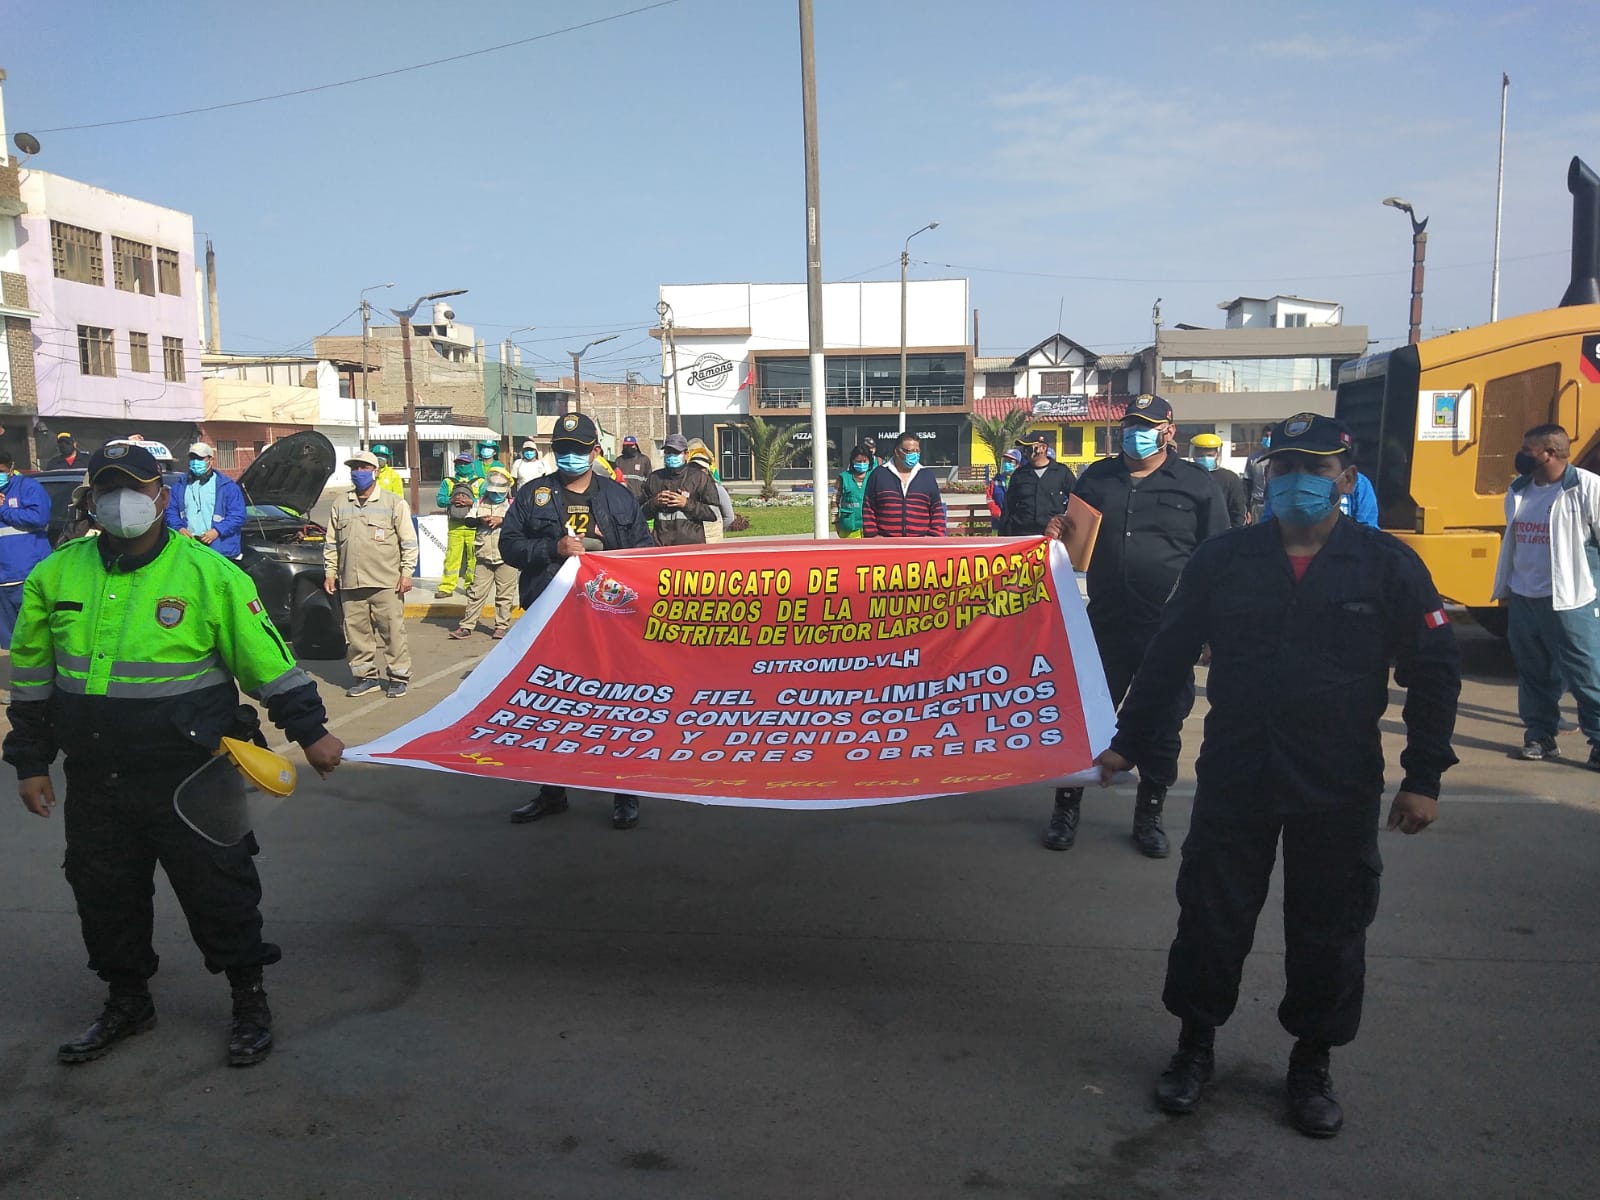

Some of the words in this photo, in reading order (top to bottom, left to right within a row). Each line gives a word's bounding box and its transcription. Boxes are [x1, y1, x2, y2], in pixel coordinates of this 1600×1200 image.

[878, 431, 936, 439] HAMBESAS
[566, 513, 590, 533] 42
[658, 568, 791, 597] SINDICATO
[808, 567, 839, 594] DE
[856, 540, 1048, 592] TRABAJADOR
[644, 615, 752, 647] DISTRITAL
[757, 625, 787, 646] DE
[792, 622, 872, 645] VICTOR
[876, 609, 949, 640] LARCO
[652, 599, 761, 623] OBREROS
[777, 599, 808, 623] DE
[823, 597, 852, 621] LA
[752, 648, 920, 674] SITROMUD-VLH
[528, 664, 674, 703] EXIGIMOS
[691, 690, 754, 706] FIEL
[777, 665, 1008, 706] CUMPLIMIENTO
[1031, 654, 1053, 677] A
[509, 689, 668, 726] NUESTROS
[676, 710, 852, 727] CONVENIOS
[860, 681, 1056, 726] COLECTIVOS
[487, 709, 655, 743] RESPETO
[681, 730, 703, 745] Y
[725, 728, 909, 746] DIGNIDAD
[935, 722, 959, 739] A
[987, 705, 1060, 732] LOS
[469, 726, 815, 763] TRABAJADORES
[845, 728, 1064, 761] OBREROS
